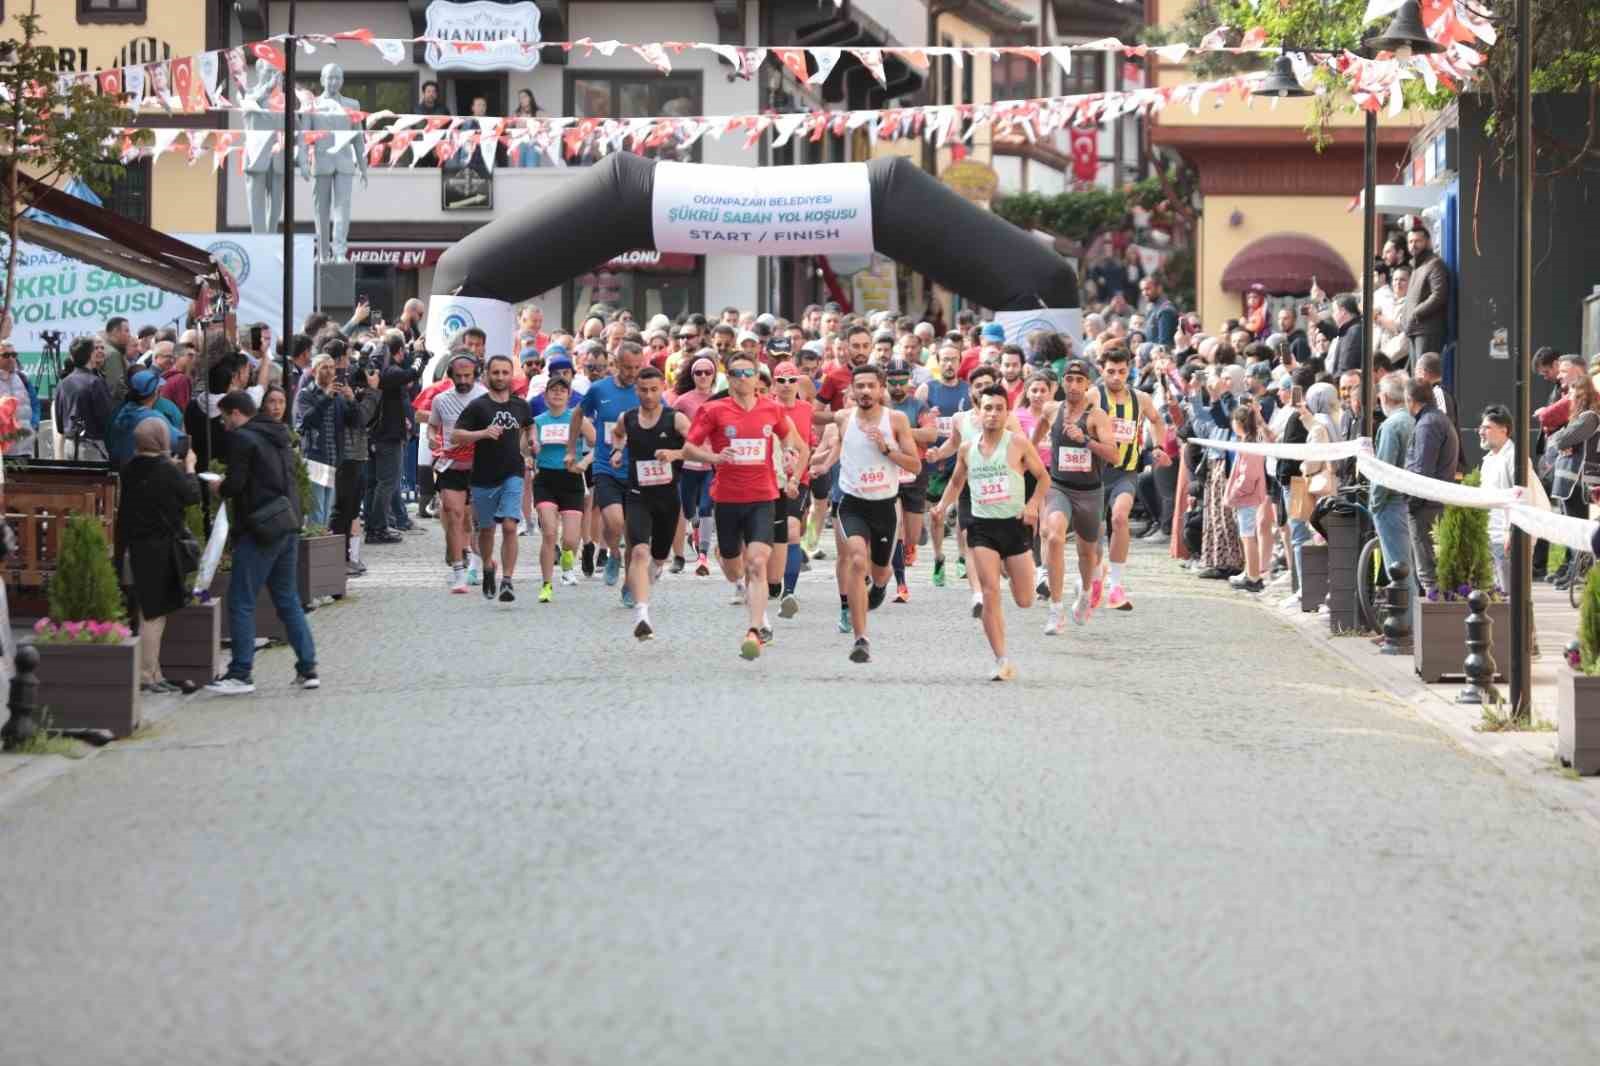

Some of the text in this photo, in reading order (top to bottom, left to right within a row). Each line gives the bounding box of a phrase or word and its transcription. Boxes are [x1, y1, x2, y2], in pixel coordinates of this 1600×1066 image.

[694, 195, 767, 207] ODUNPAZARI
[669, 206, 719, 222] ŞÜKRÜ
[779, 211, 800, 222] YOL
[805, 208, 857, 223] KOŞUSU
[689, 228, 840, 242] START / FINISH
[350, 249, 400, 263] HEDİYE
[11, 266, 77, 298] KRÜ
[12, 292, 164, 324] YOL KOŞUSU
[643, 466, 664, 476] 311
[860, 472, 885, 483] 499
[980, 485, 1003, 495] 321
